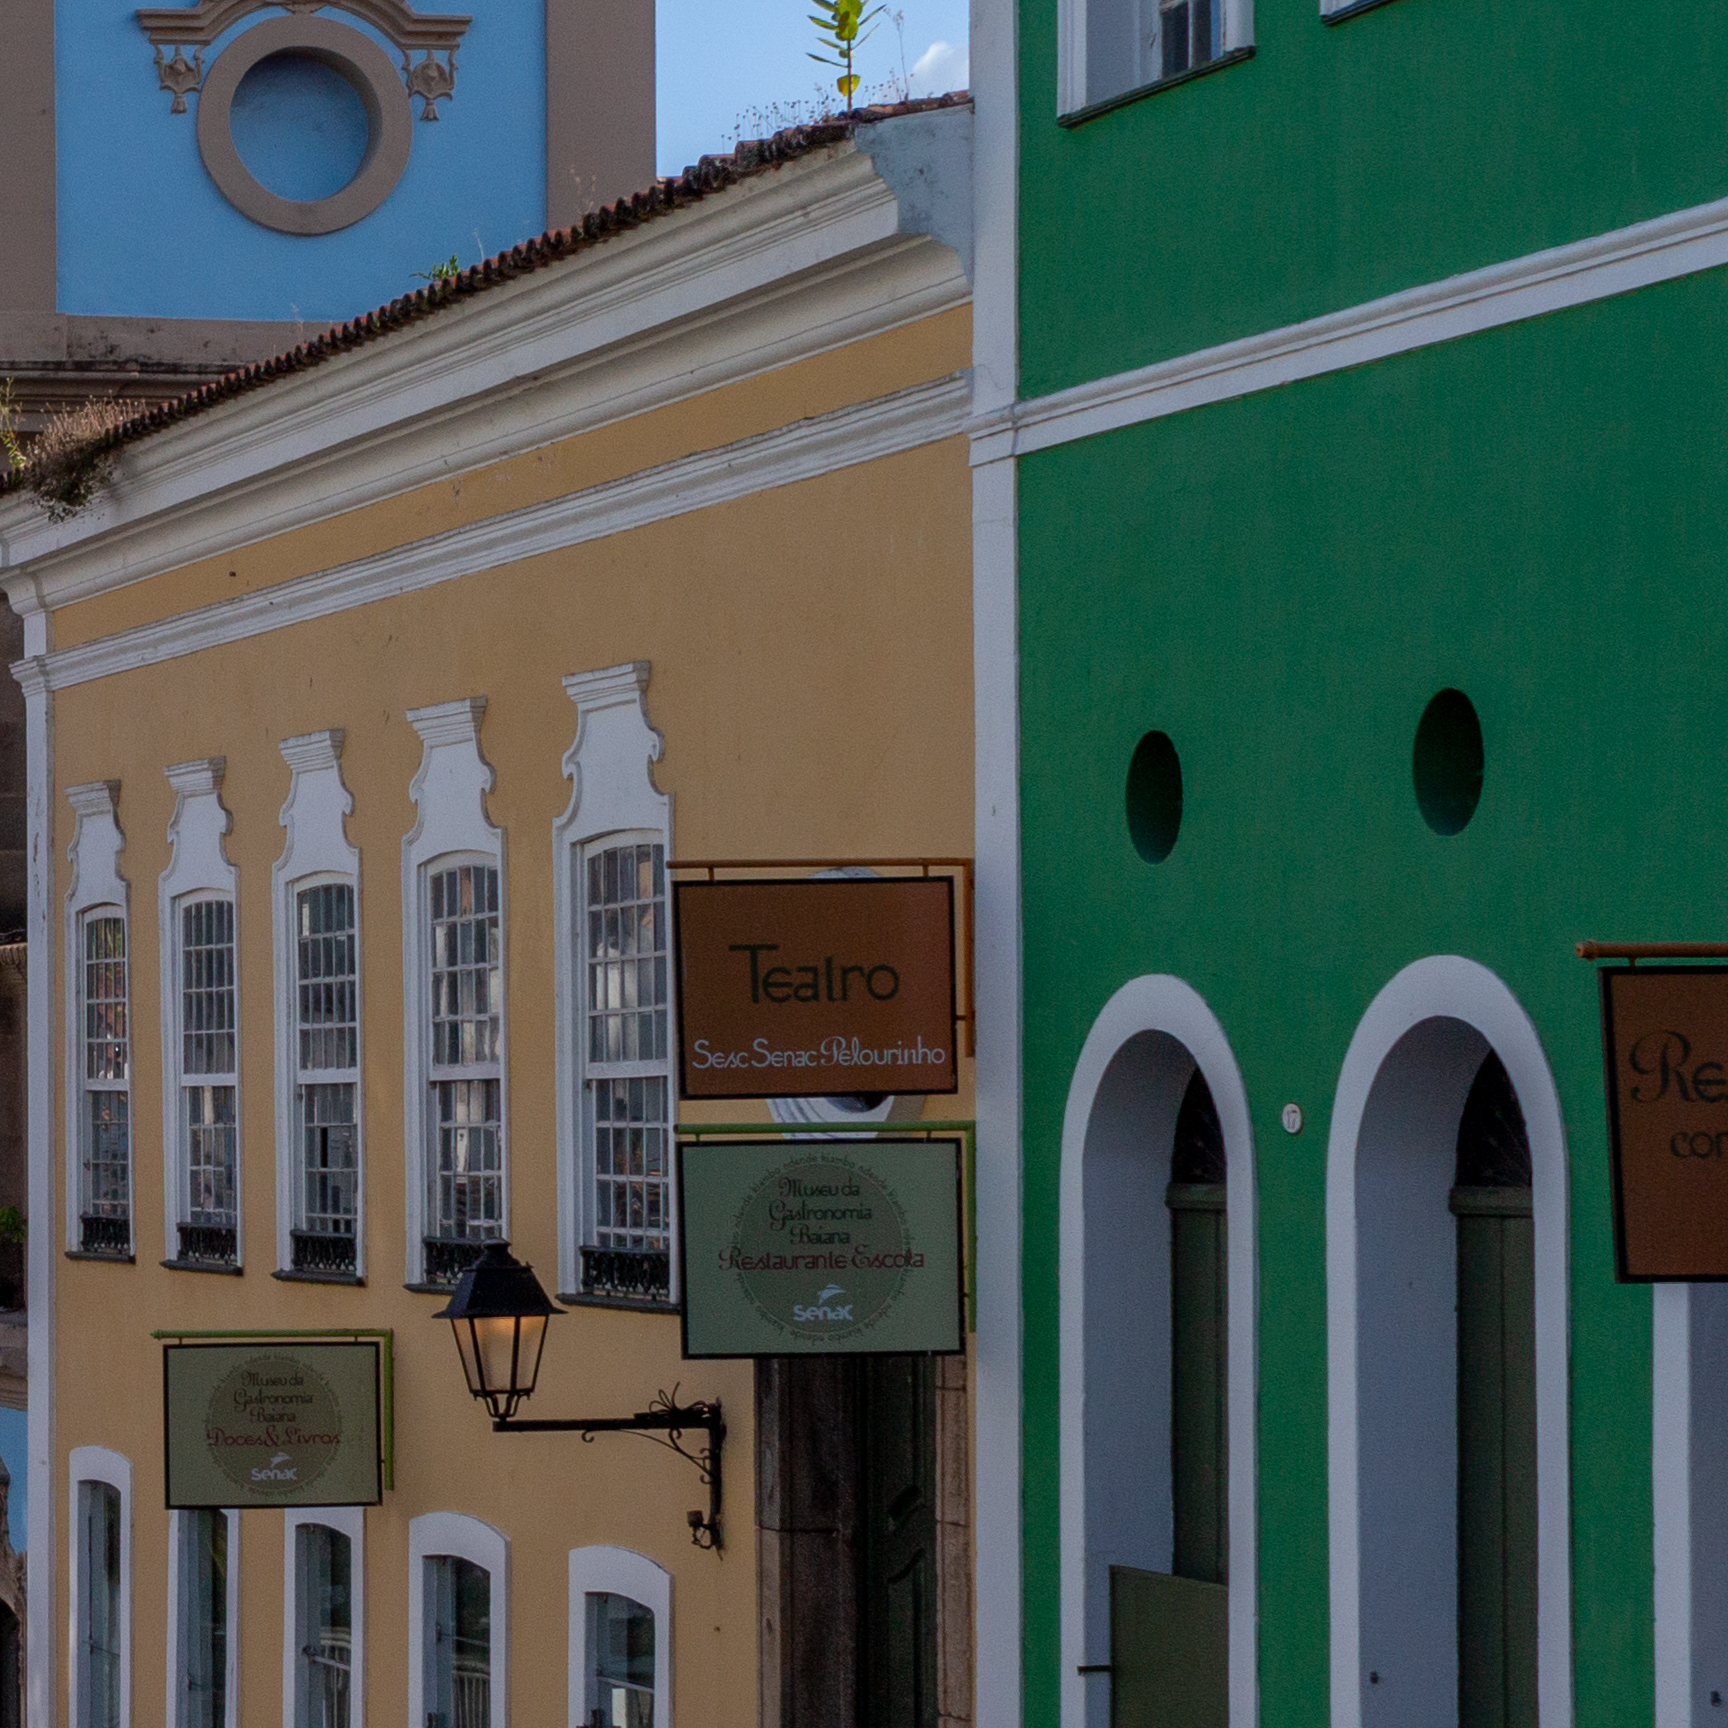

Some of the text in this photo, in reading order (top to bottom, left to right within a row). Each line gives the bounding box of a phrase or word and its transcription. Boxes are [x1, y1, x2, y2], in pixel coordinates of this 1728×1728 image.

[728, 944, 900, 1003] Teatro
[693, 1035, 946, 1069] Sesc Senac Pelourinho
[779, 1176, 861, 1197] Museu da
[769, 1199, 872, 1231] Gastronomia
[790, 1224, 851, 1246] Baiana
[718, 1244, 925, 1271] Restaurante Escola
[242, 1371, 305, 1388] Museu da
[234, 1388, 313, 1412] Gastronomia
[250, 1407, 297, 1423] Baiana
[283, 1426, 341, 1446] Livros
